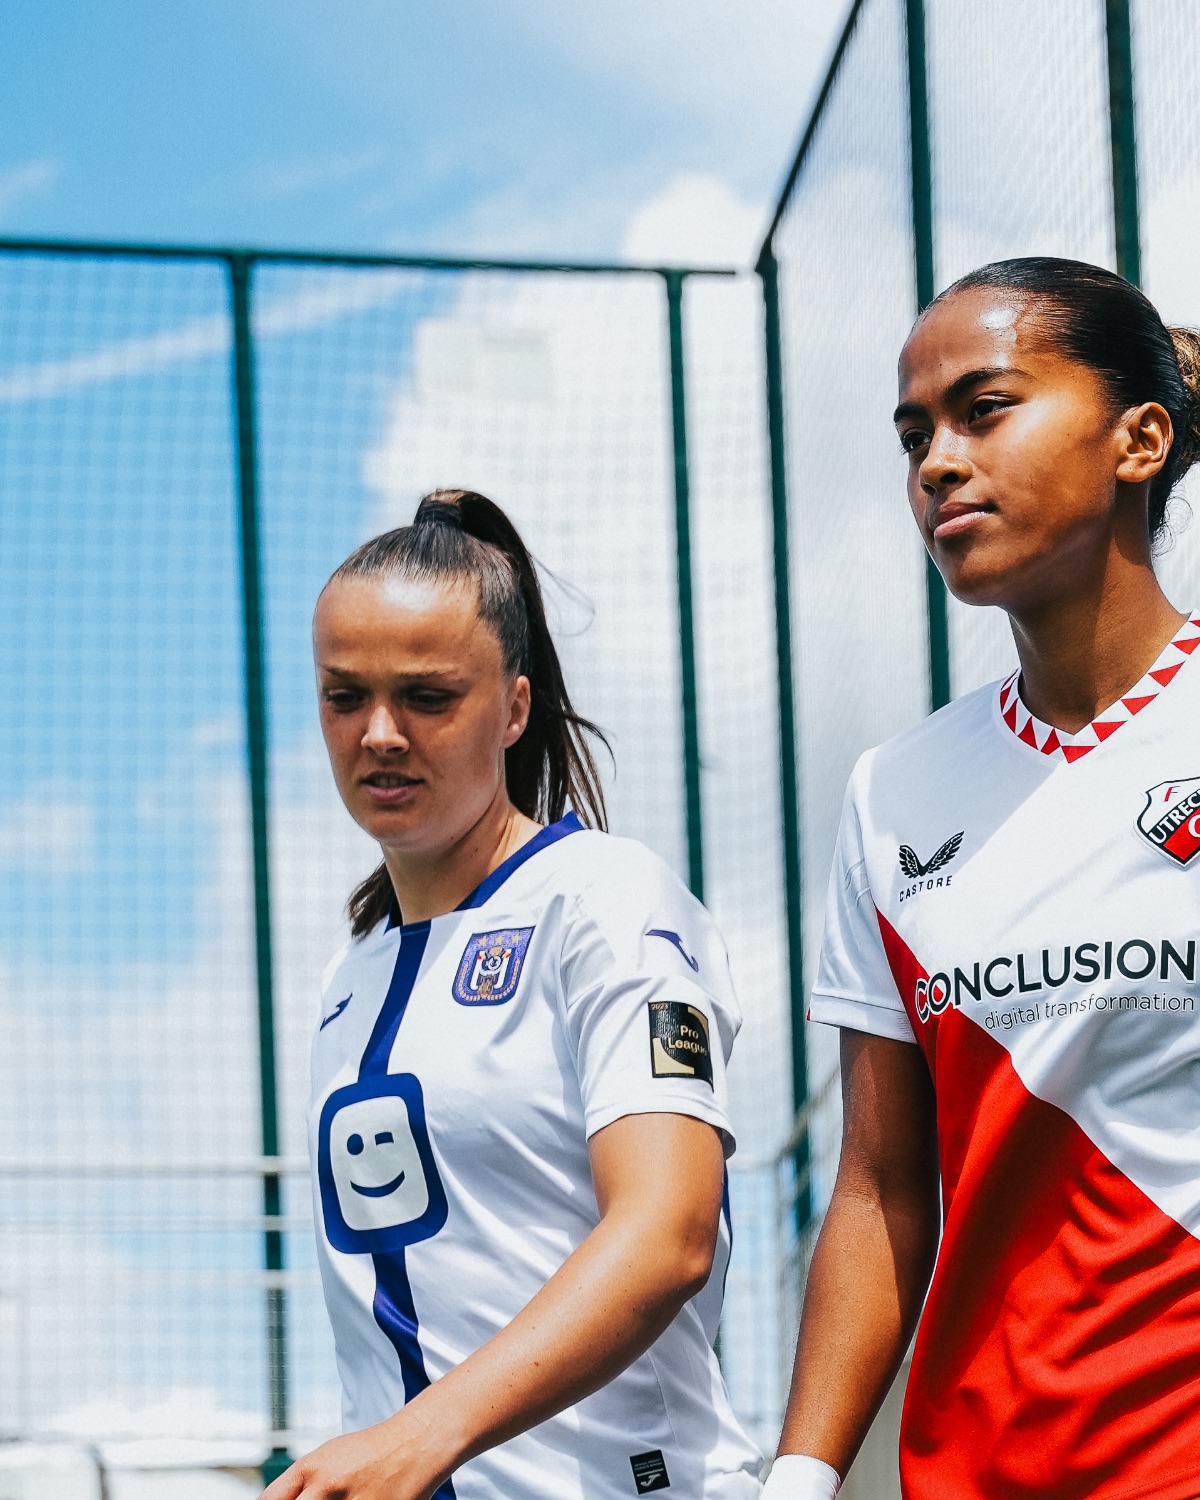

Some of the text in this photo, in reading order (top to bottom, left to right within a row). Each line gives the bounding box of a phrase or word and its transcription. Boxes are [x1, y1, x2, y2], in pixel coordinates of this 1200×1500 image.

[1164, 785, 1181, 802] F
[899, 875, 953, 903] CASTORE
[915, 939, 1197, 1024] CONCLUSION
[984, 992, 1196, 1031] digital transformation
[680, 1024, 699, 1039] Pro
